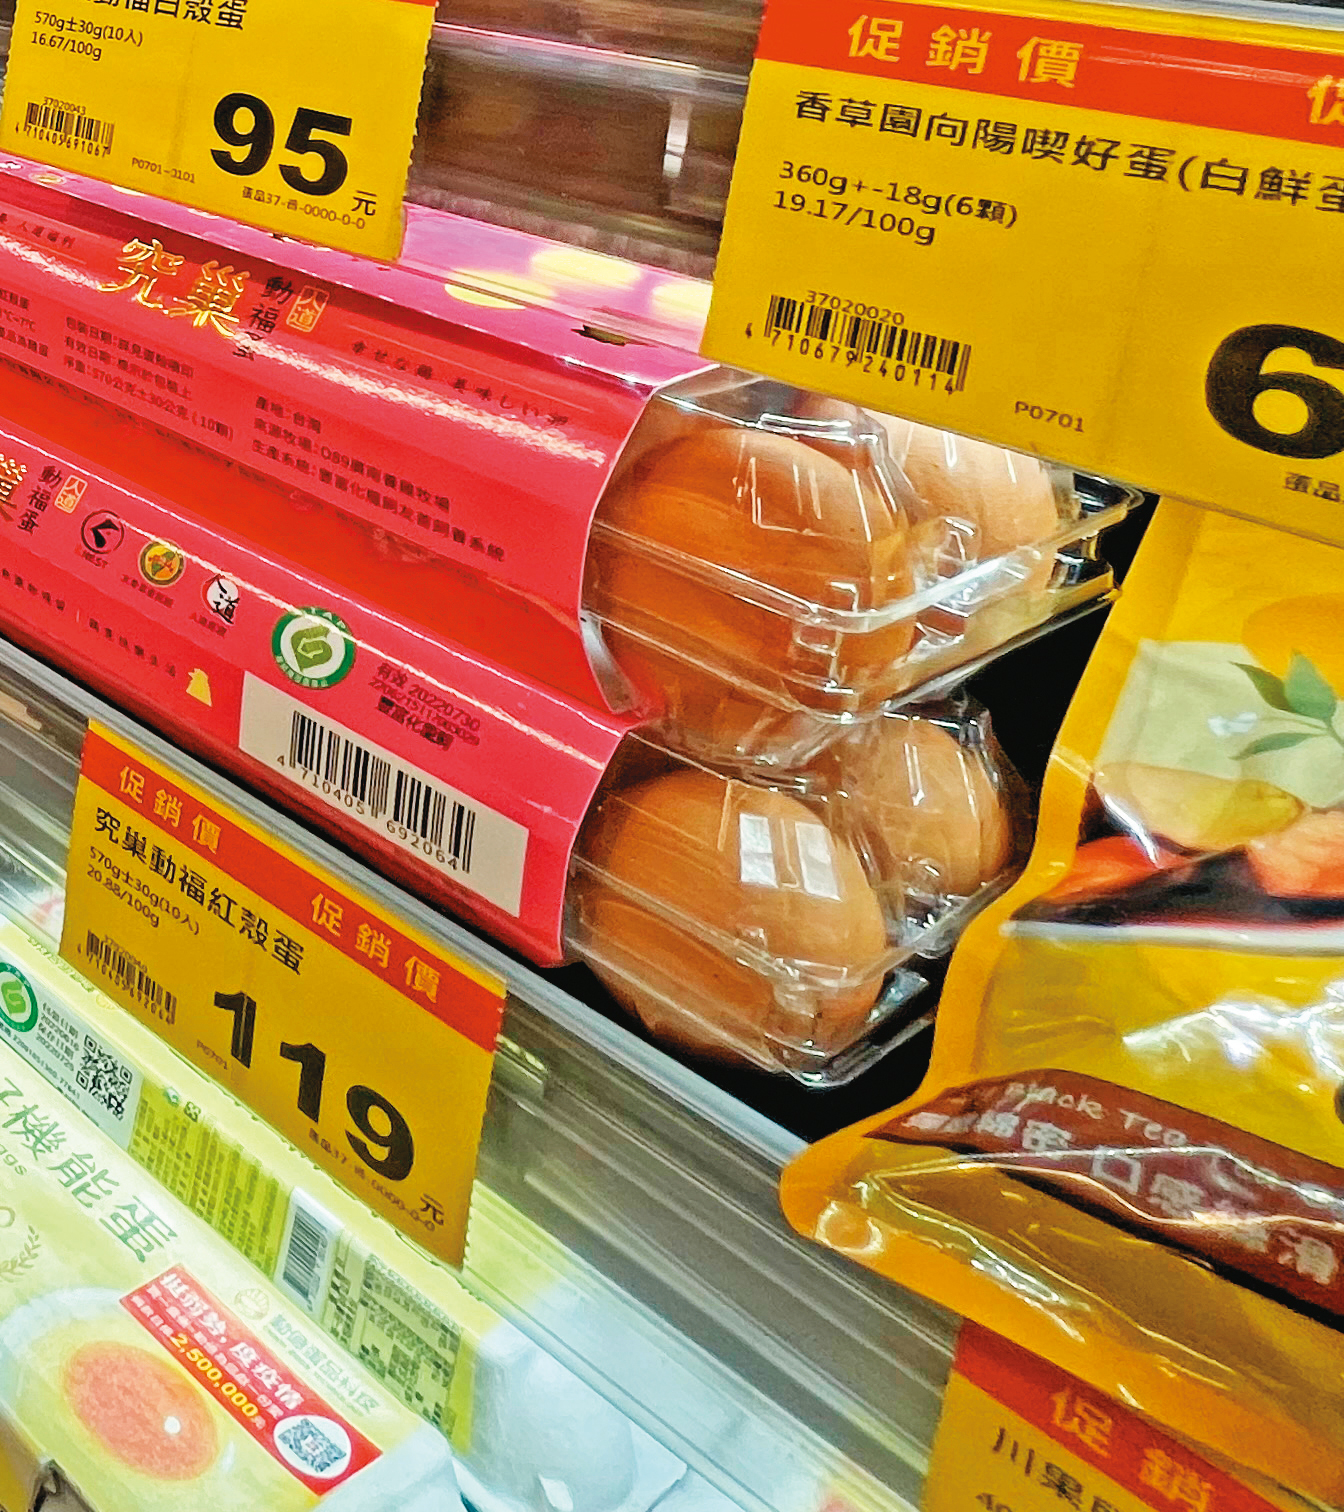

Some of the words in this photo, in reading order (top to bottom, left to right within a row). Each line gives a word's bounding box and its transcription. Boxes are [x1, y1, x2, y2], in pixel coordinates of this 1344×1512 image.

[30, 31, 102, 61] 16.67/100g
[847, 14, 1084, 88] 促銷價
[210, 92, 353, 196] 95
[352, 189, 377, 217] 元
[773, 190, 936, 246] 19.17/100g
[805, 290, 905, 326] 37020020
[1014, 399, 1086, 433] P0701
[16, 463, 63, 536] 動福蛋
[93, 806, 306, 976] 究巢動福紅殼蛋
[118, 763, 222, 855] 促銷價
[310, 891, 441, 1004] 促銷價
[212, 990, 415, 1183] 119
[418, 1191, 445, 1228] 元
